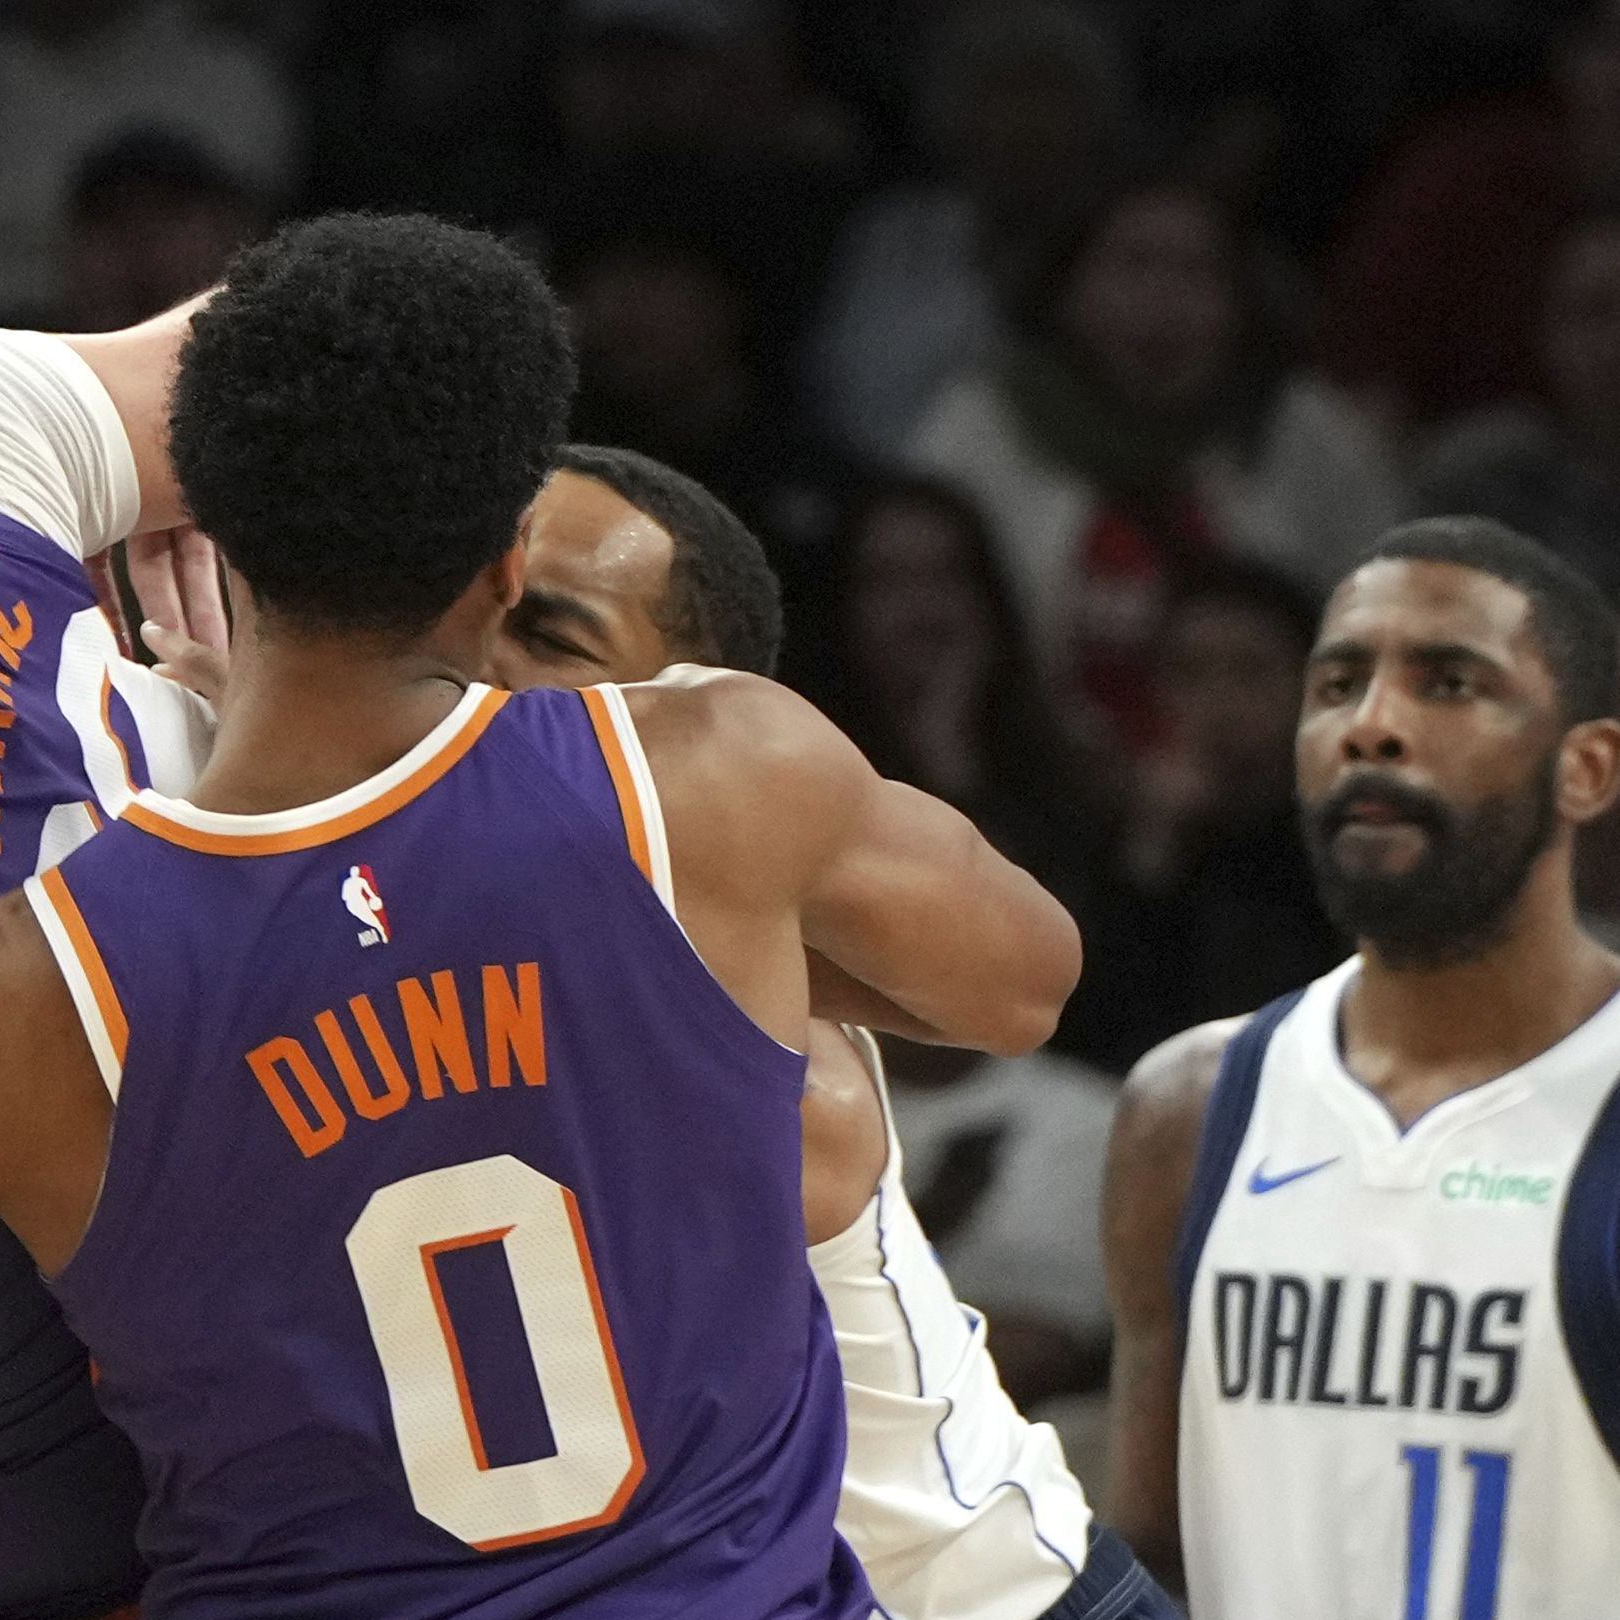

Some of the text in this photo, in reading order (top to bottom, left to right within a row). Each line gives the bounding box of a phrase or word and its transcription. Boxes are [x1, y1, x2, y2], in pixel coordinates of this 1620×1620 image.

[245, 962, 547, 1158] DUNN
[1440, 1160, 1553, 1204] chime
[345, 1154, 646, 1552] 0
[1214, 1271, 1525, 1414] DALLAS
